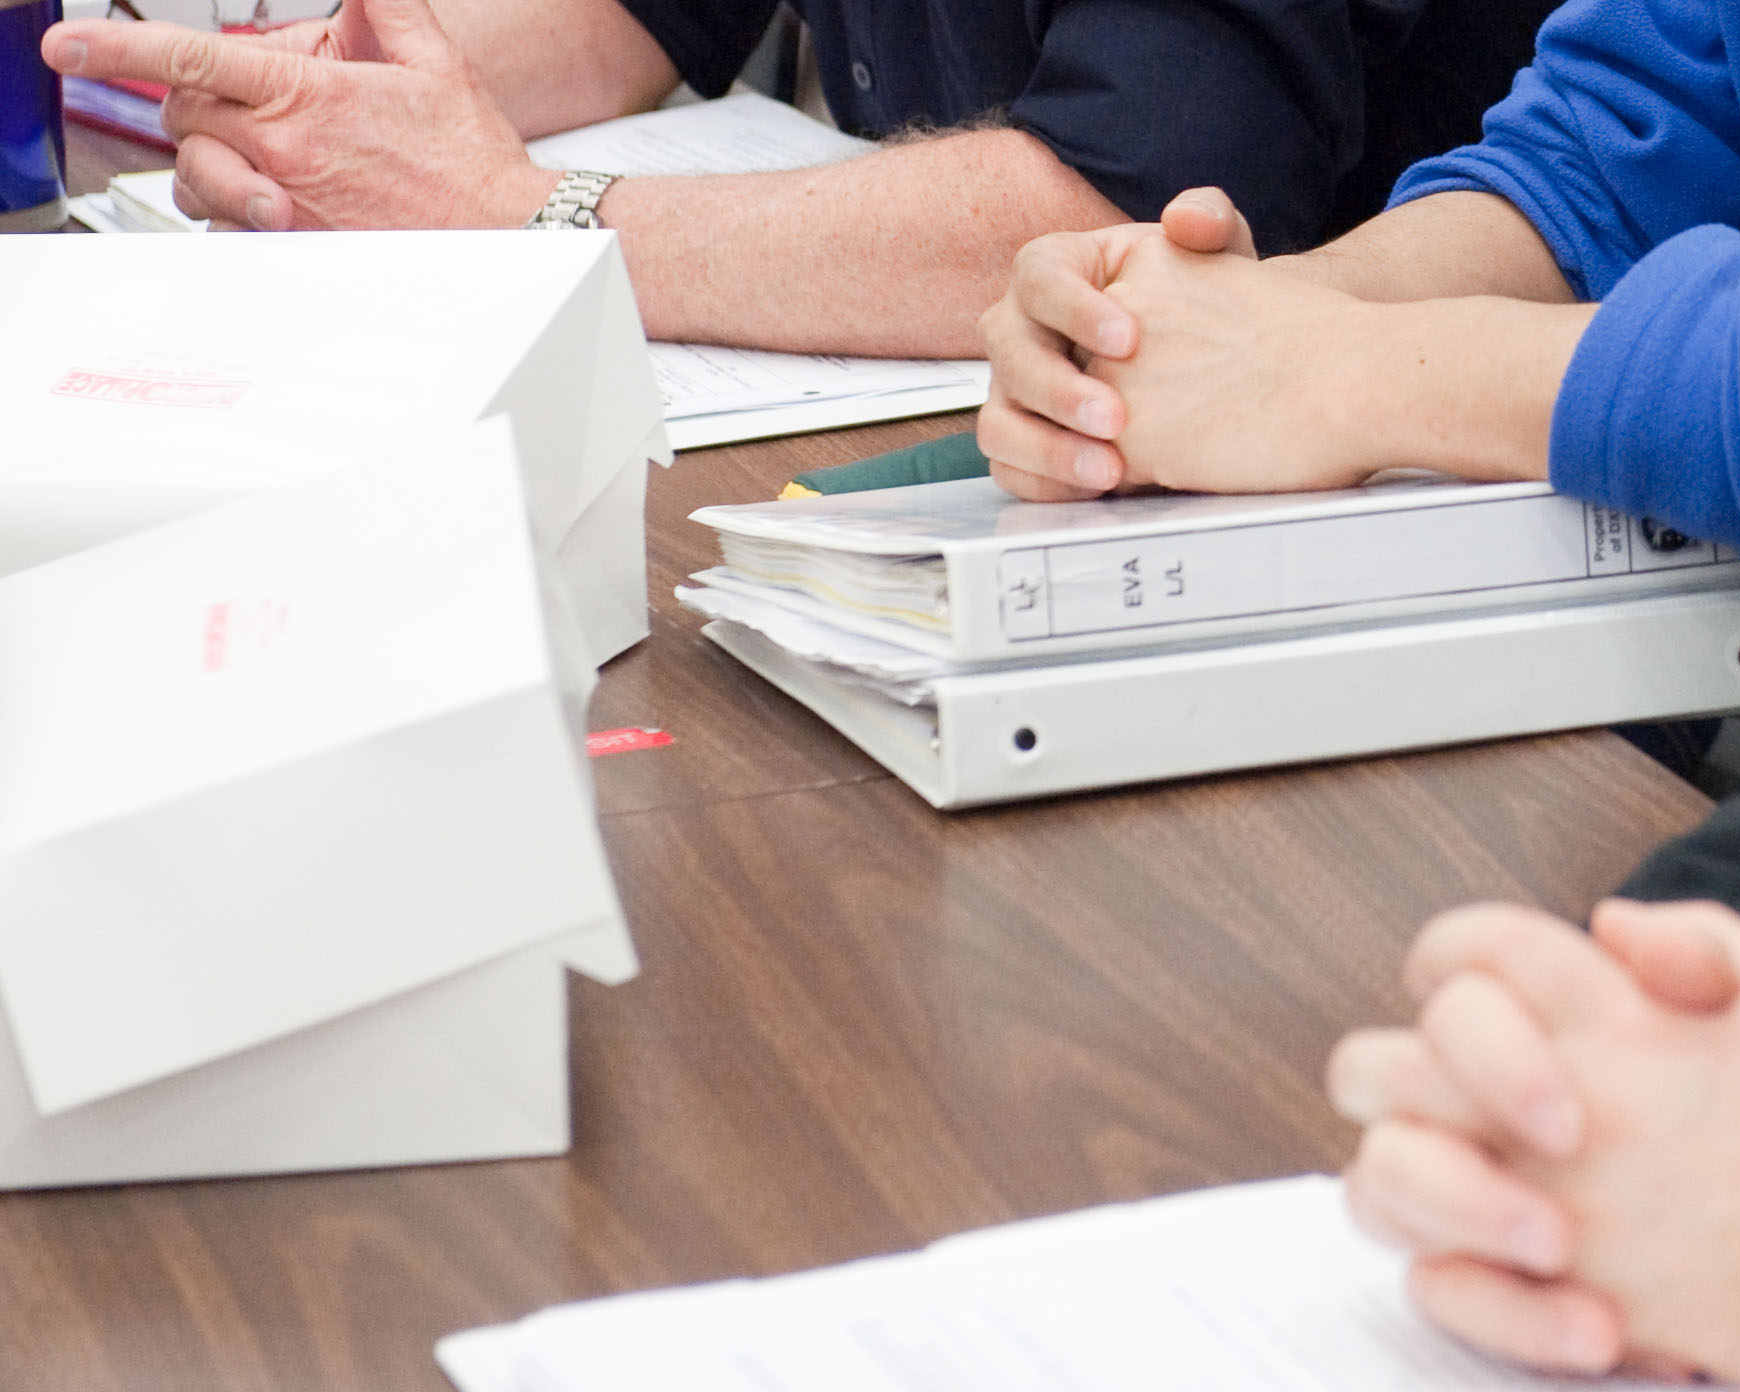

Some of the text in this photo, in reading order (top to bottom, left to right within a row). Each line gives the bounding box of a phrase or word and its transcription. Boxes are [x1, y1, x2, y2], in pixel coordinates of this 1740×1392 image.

[1592, 504, 1605, 563] Propert
[1609, 538, 1621, 553] of
[1122, 557, 1142, 608] EVA
[1165, 560, 1184, 597] L/L
